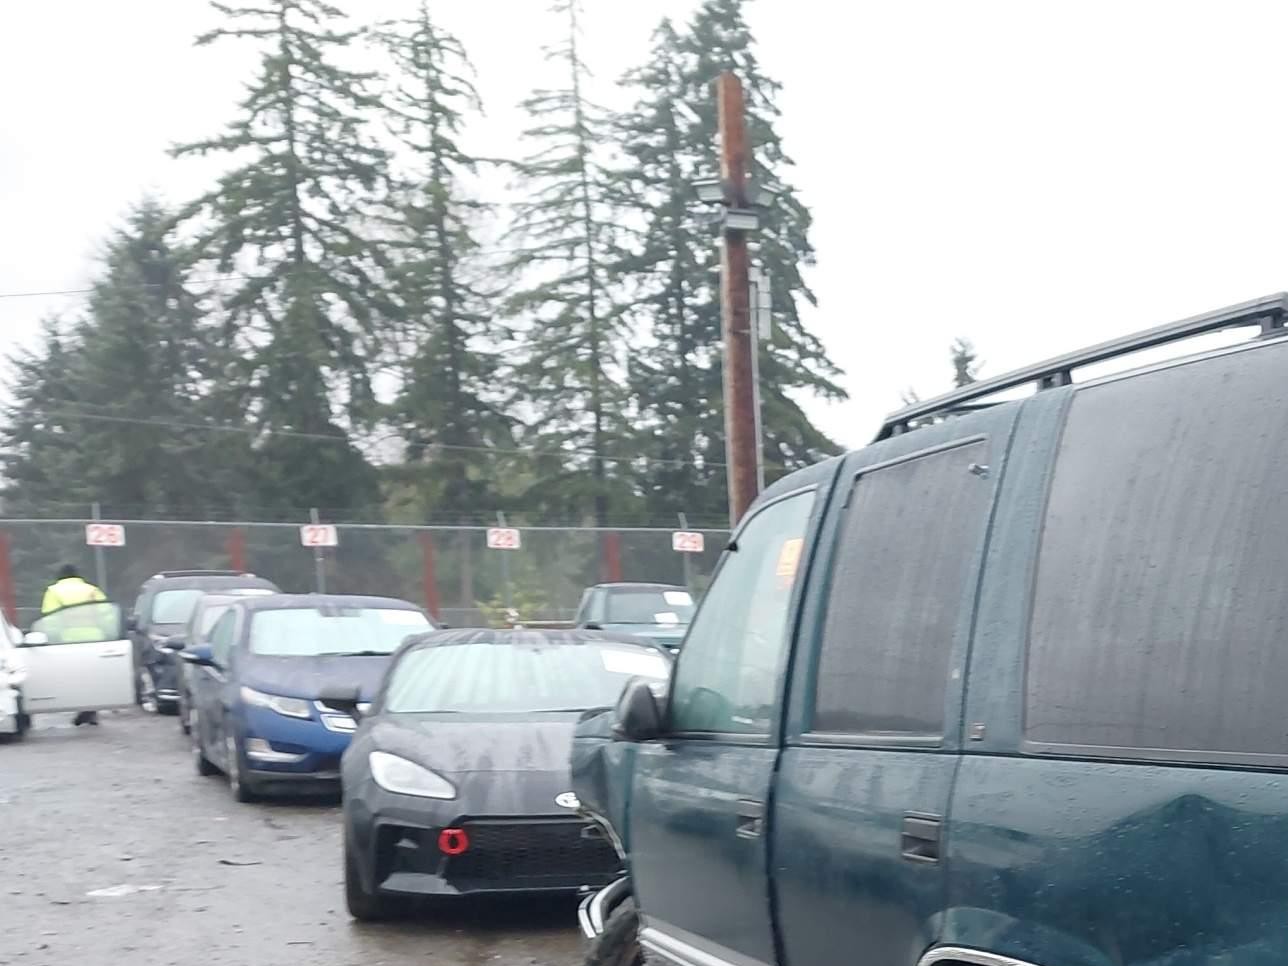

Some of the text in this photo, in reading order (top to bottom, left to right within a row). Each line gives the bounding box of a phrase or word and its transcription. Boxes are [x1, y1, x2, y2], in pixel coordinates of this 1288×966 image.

[308, 527, 328, 544] 27
[493, 530, 513, 546] 28
[680, 533, 699, 549] 29
